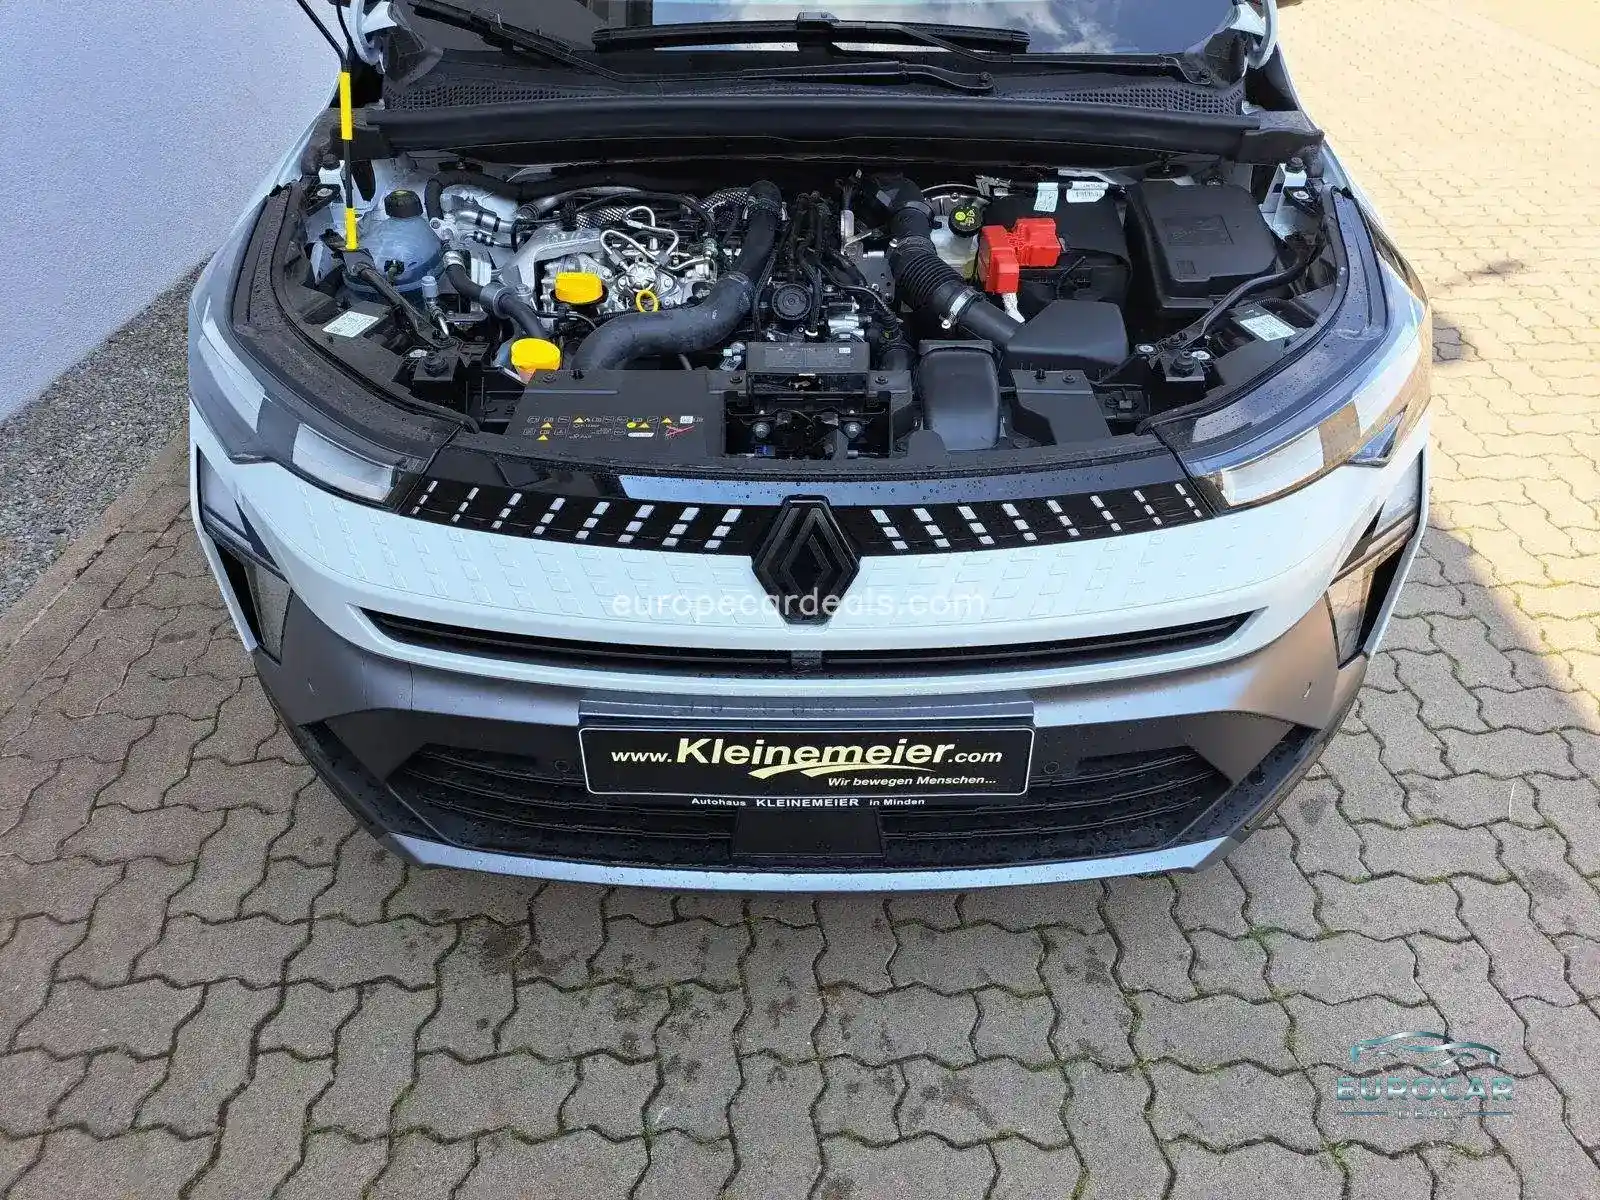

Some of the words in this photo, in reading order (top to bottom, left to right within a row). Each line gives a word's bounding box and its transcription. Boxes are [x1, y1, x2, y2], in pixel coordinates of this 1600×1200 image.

[610, 737, 1003, 765] www.Kleinemeier.com
[828, 777, 850, 788] Wir
[853, 777, 914, 788] bewegen
[916, 775, 997, 786] Menschen...
[691, 798, 746, 807] Autohaus
[756, 798, 859, 807] KLEINEMEIER
[868, 798, 881, 807] in
[883, 798, 925, 807] Minden
